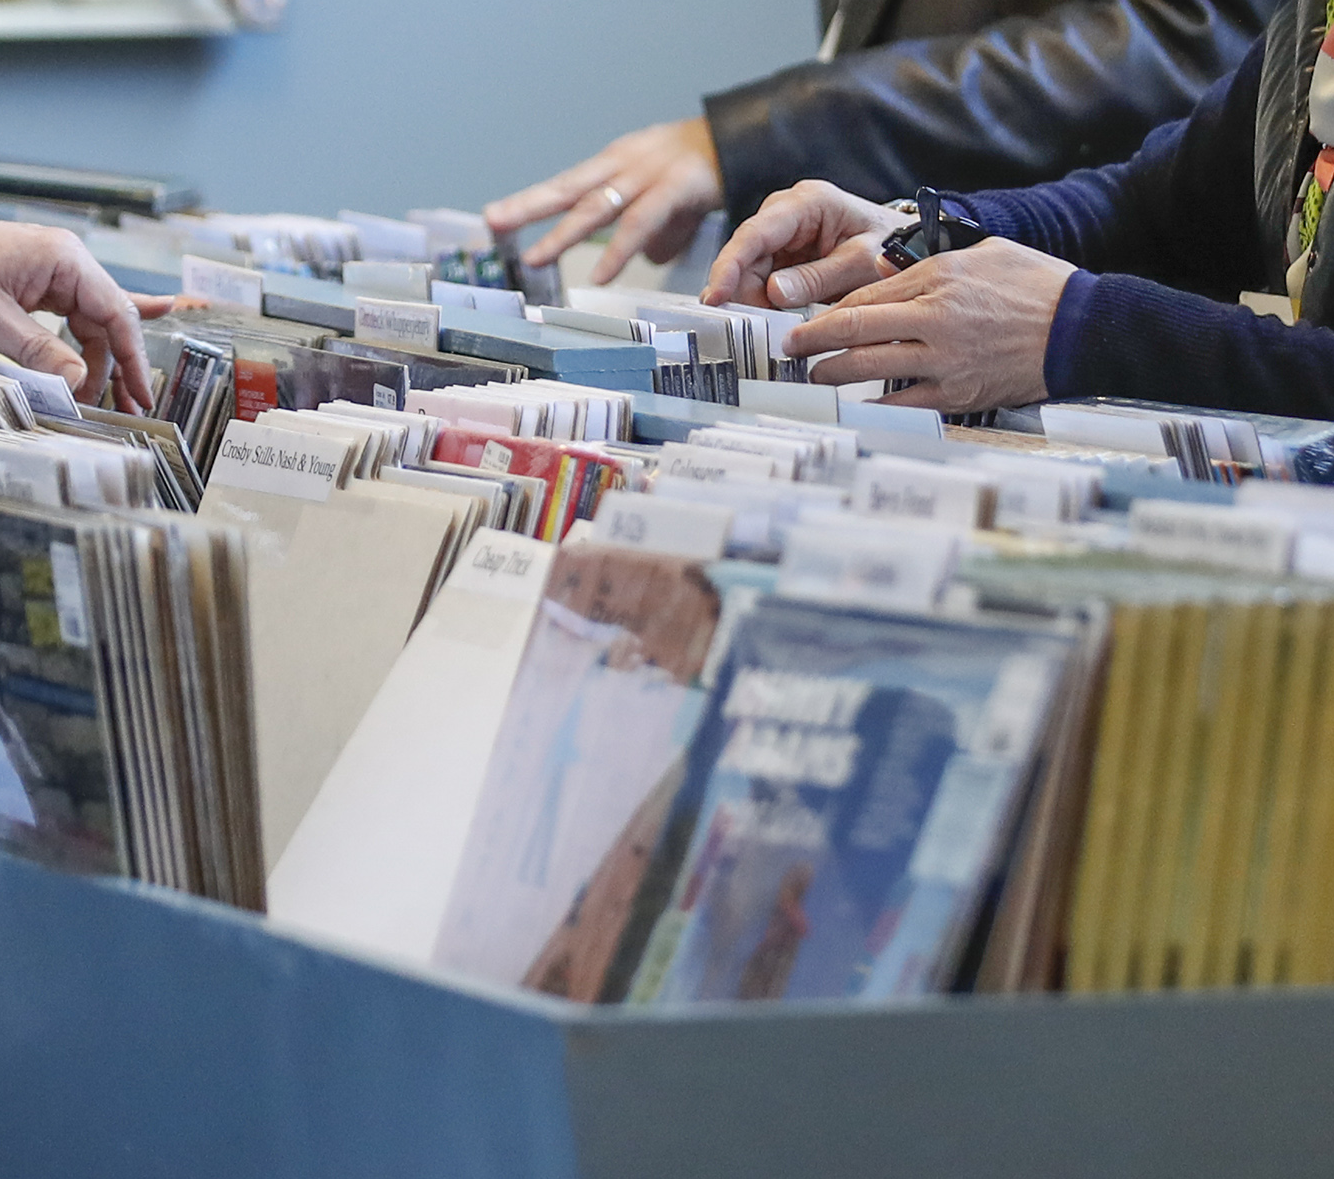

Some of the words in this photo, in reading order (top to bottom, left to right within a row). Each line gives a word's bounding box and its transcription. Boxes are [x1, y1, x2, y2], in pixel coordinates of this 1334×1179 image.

[222, 440, 253, 466] Crosby
[252, 445, 276, 467] Stills
[274, 449, 299, 473] Nash
[297, 453, 308, 472] &
[308, 455, 337, 481] Young
